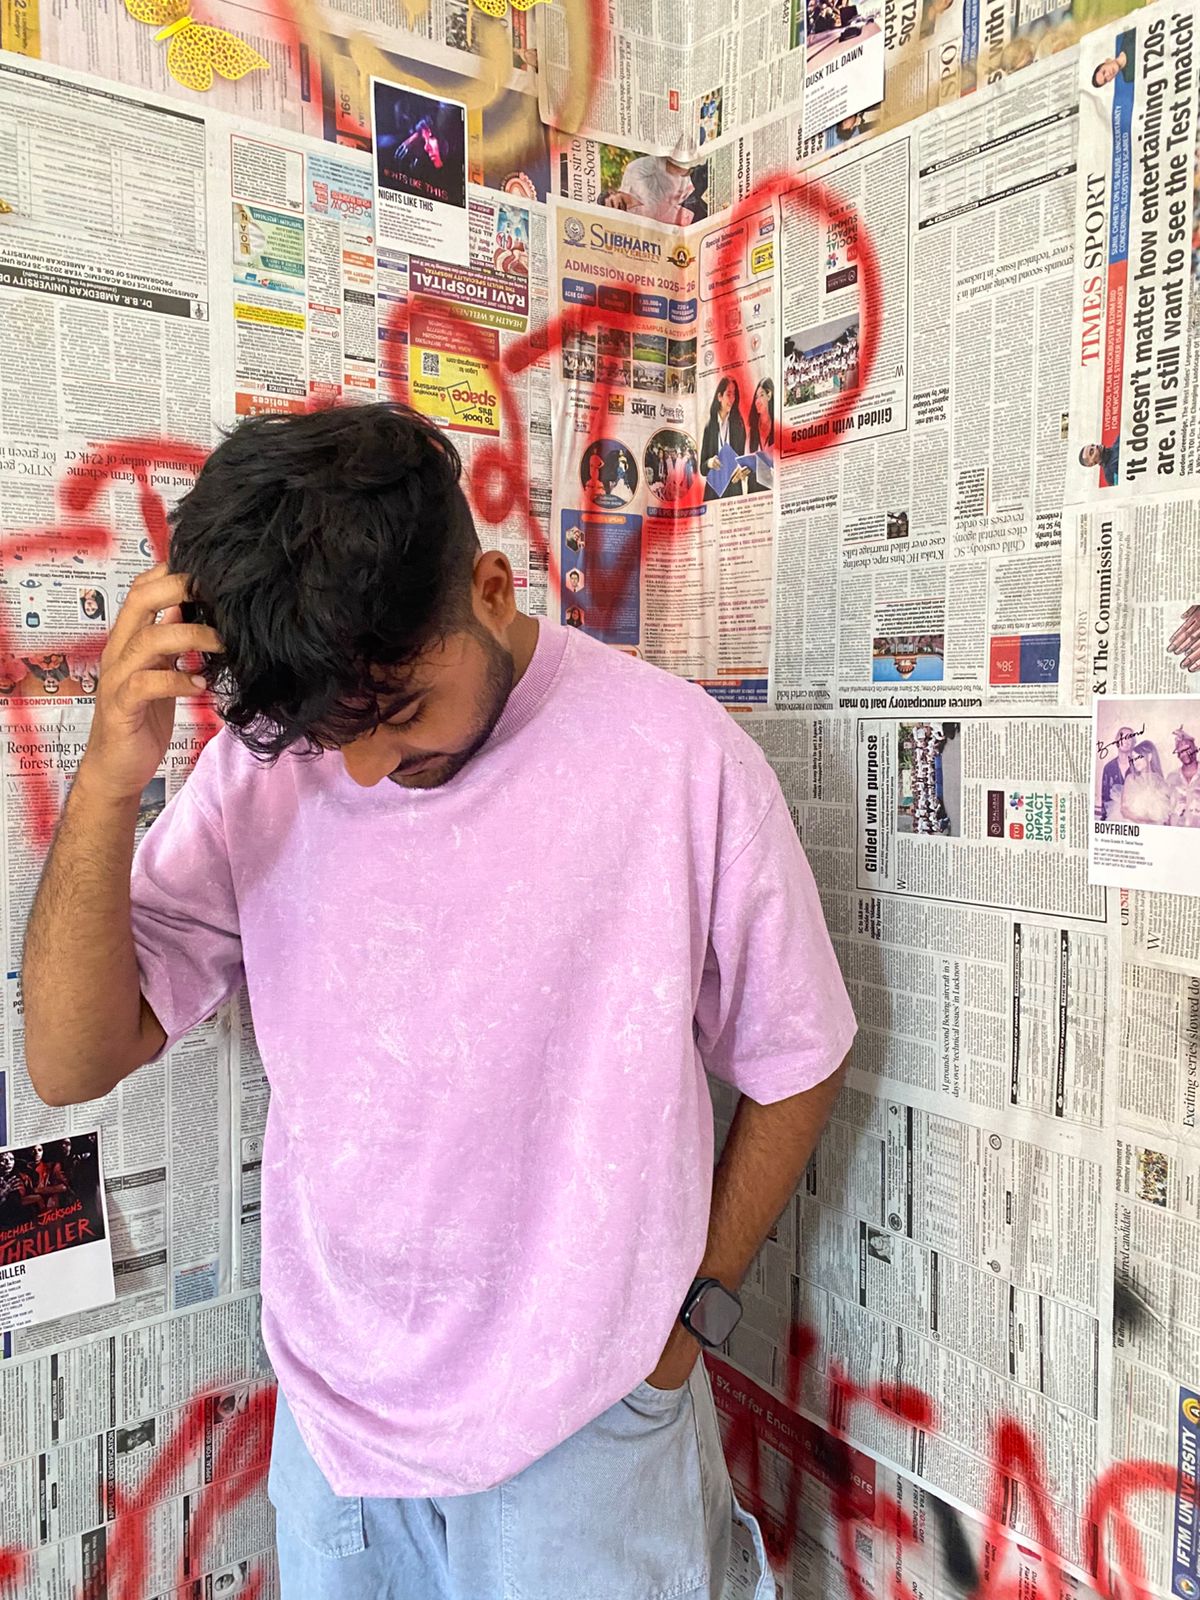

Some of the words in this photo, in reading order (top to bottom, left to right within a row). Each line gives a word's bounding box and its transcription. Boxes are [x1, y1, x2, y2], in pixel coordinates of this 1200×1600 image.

[1143, 19, 1165, 78] T20s
[1171, 14, 1193, 94] match'
[805, 70, 824, 88] DUSK
[825, 60, 839, 79] TILL
[841, 45, 863, 70] DAWN
[1114, 105, 1122, 153] UNCERTAINTY
[1166, 96, 1190, 152] Test
[572, 139, 581, 152] to
[1139, 79, 1167, 223] entertaining
[570, 154, 581, 171] sir
[1165, 154, 1188, 196] the
[378, 189, 402, 203] NIGHTS
[404, 196, 417, 208] LIKE
[419, 199, 433, 211] THIS
[1113, 191, 1120, 202] ON
[331, 201, 363, 215] GROW
[827, 215, 858, 234] SUMMIT
[1084, 173, 1106, 269] SPORT
[1167, 200, 1186, 243] see
[591, 224, 661, 255] SUBHARTI
[827, 224, 858, 243] IMPACT
[827, 234, 858, 252] SOCIAL
[2, 249, 44, 262] UNIVERSITY
[46, 257, 86, 269] AMBEDKAR
[1134, 231, 1157, 280] how
[1164, 250, 1184, 275] to
[15, 260, 31, 268] FOR
[64, 269, 82, 277] YEAR
[84, 273, 120, 284] ACADEMIC
[125, 272, 173, 286] PROGRAMMES
[565, 259, 625, 282] ADMISSION
[626, 271, 655, 288] OPEN
[1019, 267, 1043, 282] second
[13, 276, 67, 293] UNIVERSITY
[137, 282, 161, 292] NOTICE
[413, 272, 486, 299] HOSPITAL
[970, 283, 993, 298] aircraft
[69, 285, 119, 303] AMBEDKAR
[124, 295, 138, 305] B.R.
[162, 288, 198, 299] ADMISSION
[493, 289, 525, 307] RAVI
[141, 299, 152, 308] Dr.
[1162, 279, 1183, 341] want
[452, 307, 487, 320] WELLNESS
[1082, 276, 1102, 366] TIMES
[496, 316, 522, 327] HEALTH
[1133, 286, 1155, 363] matter
[1107, 325, 1115, 373] BLOCKBUSTER
[1158, 346, 1180, 389] still
[413, 381, 446, 392] advertising
[252, 396, 288, 407] notices
[452, 389, 496, 407] space
[479, 407, 492, 416] this
[1127, 367, 1151, 451] doesn't
[1155, 394, 1177, 424] I'll
[463, 413, 482, 424] book
[485, 417, 494, 425] To
[858, 408, 891, 429] Gilded
[791, 423, 829, 443] purpose
[832, 417, 854, 436] with
[9, 448, 39, 458] green
[43, 452, 56, 462] for
[65, 451, 76, 459] cr
[1158, 430, 1175, 474] are.
[121, 456, 151, 467] outlay
[153, 460, 187, 471] annual
[19, 464, 53, 476] NTPC
[67, 467, 108, 478] scheme
[111, 471, 137, 484] farm
[139, 475, 148, 483] to
[151, 475, 169, 484] nod
[956, 520, 977, 531] order
[979, 518, 988, 528] its
[991, 513, 1024, 524] reverses
[979, 529, 1006, 541] mental
[1008, 526, 1027, 537] cites
[891, 542, 909, 553] failed
[911, 539, 927, 548] over
[929, 537, 945, 546] case
[1002, 540, 1025, 551] Child
[842, 549, 857, 559] talks
[859, 545, 889, 557] marriage
[907, 553, 919, 562] HC
[954, 548, 965, 558] SC
[843, 559, 870, 570] cheating
[890, 554, 905, 565] bins
[1095, 521, 1113, 634] Commission
[1077, 608, 1088, 651] STORY
[1037, 660, 1055, 670] 62%
[1093, 640, 1108, 675] The
[996, 661, 1013, 672] 38%
[1092, 680, 1107, 694] &
[777, 690, 789, 700] held
[839, 699, 858, 708] man
[859, 699, 868, 708] to
[7, 742, 70, 754] Reopening
[19, 757, 52, 769] forest
[866, 735, 879, 790] purpose
[865, 794, 878, 824] with
[1026, 793, 1034, 839] SOCIAL
[1035, 793, 1044, 840] IMPACT
[1044, 794, 1053, 842] SUMMIT
[1095, 823, 1140, 837] BOYFRIEND
[865, 829, 878, 872] Gilded
[952, 961, 960, 994] Lucknow
[942, 974, 950, 1000] aircraft
[942, 1002, 951, 1026] Boeing
[1184, 997, 1199, 1038] slowed
[942, 1028, 950, 1052] second
[1185, 1042, 1195, 1077] series
[942, 1054, 951, 1084] grounds
[942, 1084, 950, 1094] AI
[952, 1084, 961, 1098] days
[1182, 1079, 1196, 1127] Exciting
[0, 1221, 34, 1241] MICHAEL
[0, 1218, 95, 1264] THRILLER
[716, 1376, 730, 1393] 5%
[732, 1389, 746, 1405] off
[1179, 1426, 1196, 1525] UNIVERSITY
[1177, 1527, 1191, 1567] IFTM
